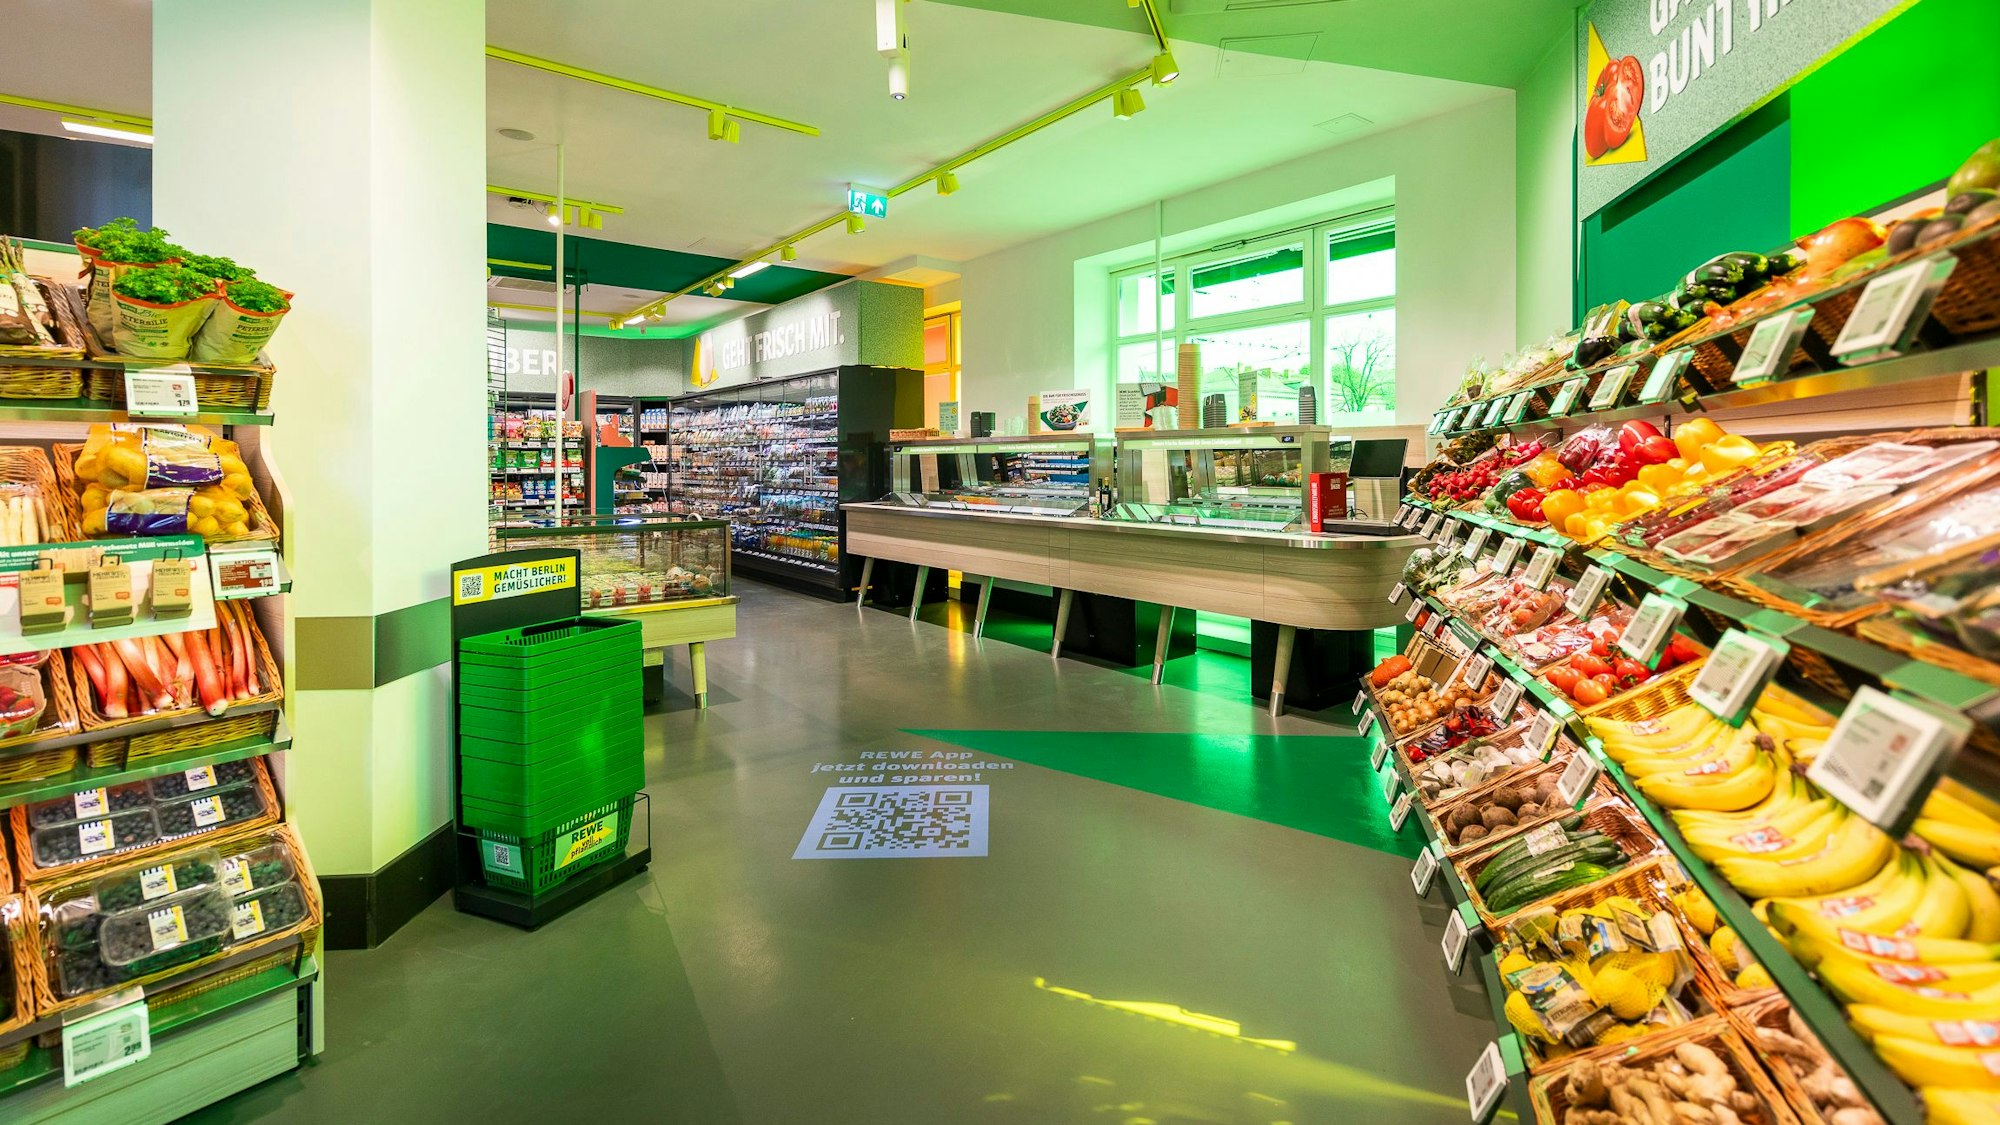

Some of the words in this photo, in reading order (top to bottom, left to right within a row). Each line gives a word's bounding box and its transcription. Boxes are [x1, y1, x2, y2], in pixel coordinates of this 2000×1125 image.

[1649, 0, 1733, 115] BUNT
[120, 311, 168, 325] PETERSILIE
[722, 336, 753, 371] GEHT
[755, 320, 806, 363] FRISCH
[809, 310, 846, 351] MIT.
[494, 568, 528, 581] MACHT
[532, 563, 566, 576] BERLIN
[494, 574, 566, 594] GEMÜSLICHER!
[860, 751, 924, 760] REWE
[930, 751, 973, 761] App
[810, 762, 866, 773] jetzt
[872, 761, 1014, 772] downloaden
[839, 774, 884, 784] und
[891, 773, 981, 785] sparen!
[572, 821, 603, 844] REWE
